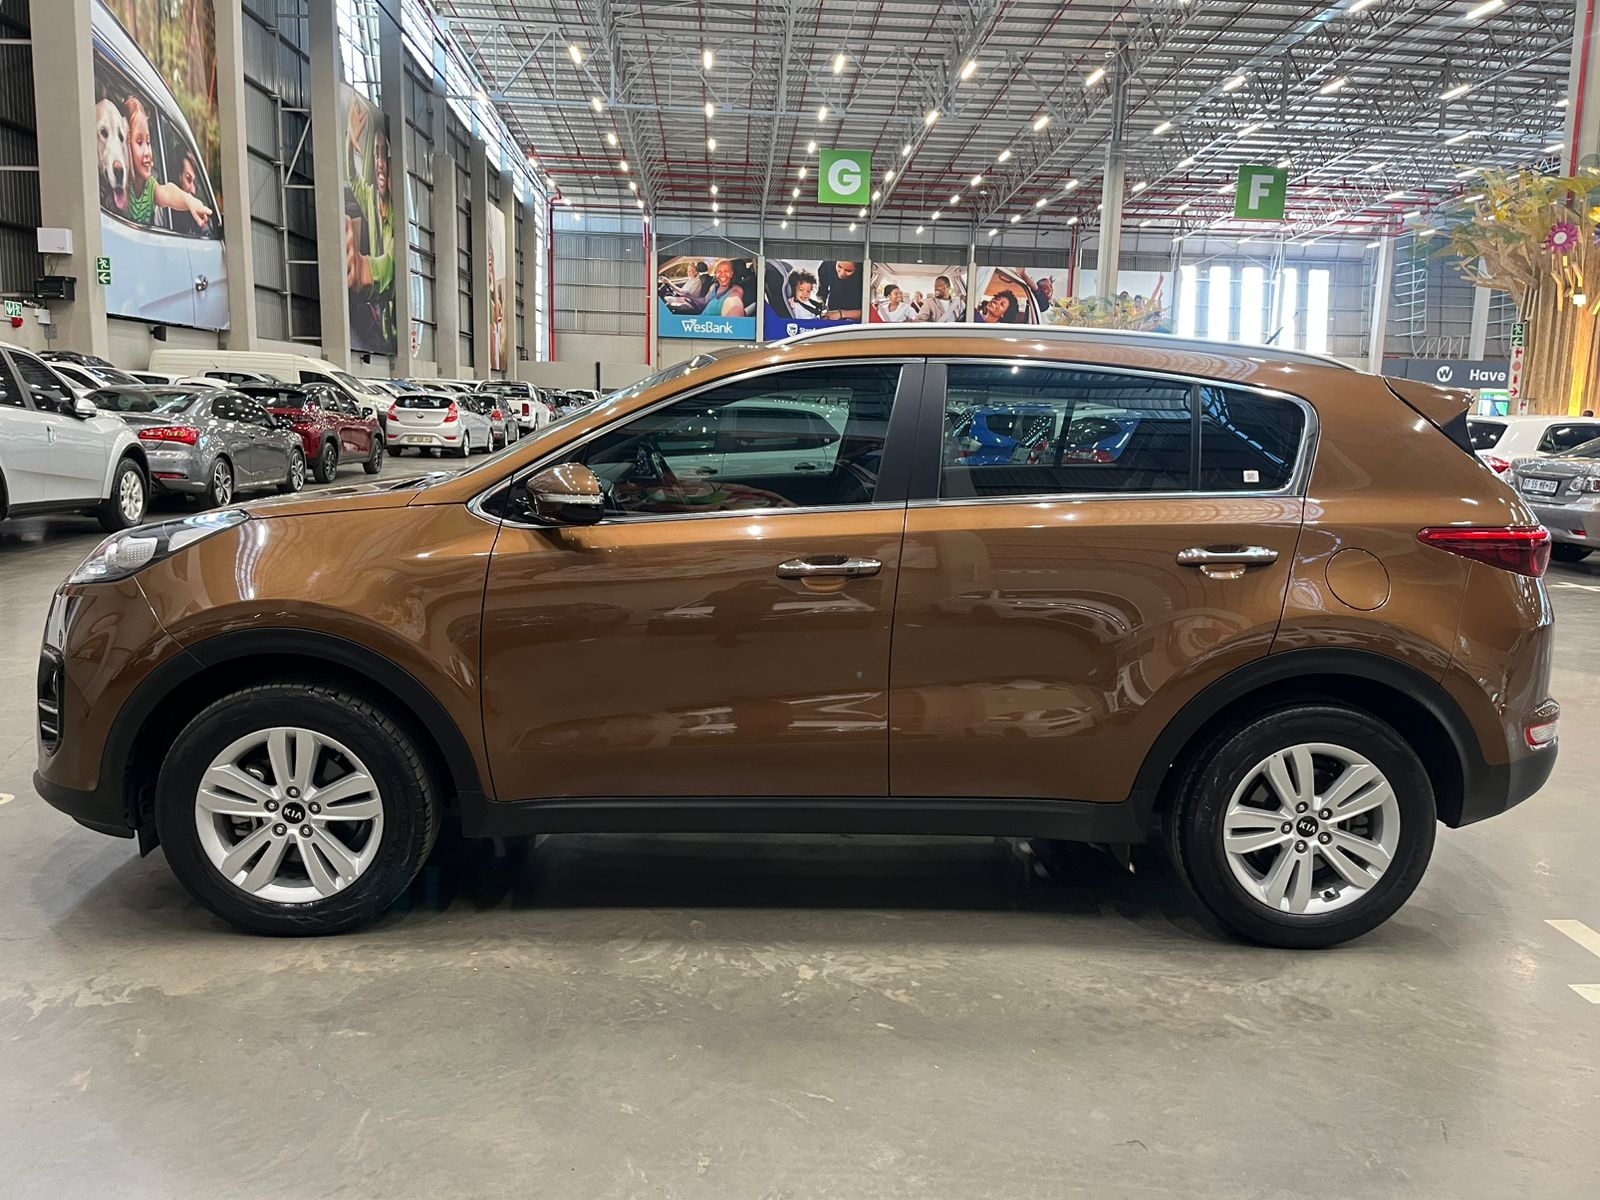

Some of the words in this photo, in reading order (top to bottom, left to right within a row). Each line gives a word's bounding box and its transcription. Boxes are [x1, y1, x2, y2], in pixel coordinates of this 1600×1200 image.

[828, 159, 862, 195] G
[1248, 174, 1274, 210] F
[681, 319, 733, 333] WesBank
[1469, 369, 1506, 382] Have
[283, 807, 302, 820] KIA
[1298, 820, 1316, 833] KIA
